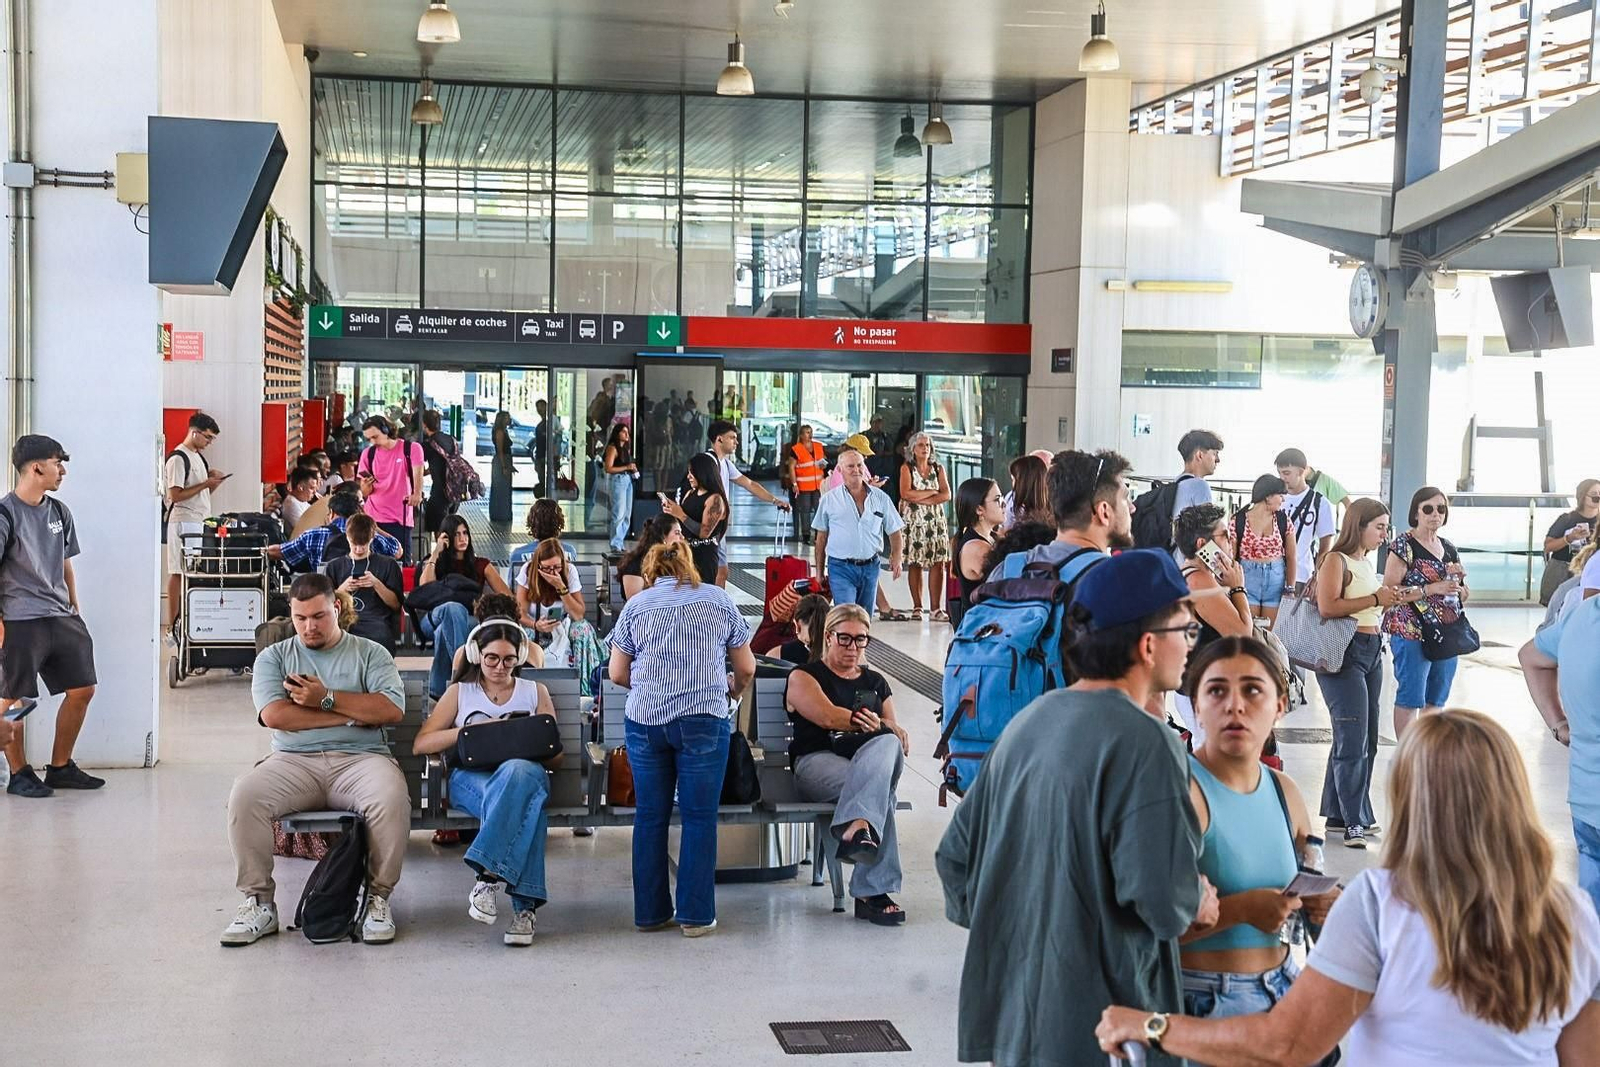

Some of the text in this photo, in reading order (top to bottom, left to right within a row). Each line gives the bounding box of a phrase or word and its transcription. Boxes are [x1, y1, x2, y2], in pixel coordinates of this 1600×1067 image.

[349, 313, 380, 323] Salida
[418, 316, 508, 327] Alquiler de coches
[545, 319, 564, 328] Taxi
[612, 320, 624, 339] P
[854, 326, 896, 338] No pasar
